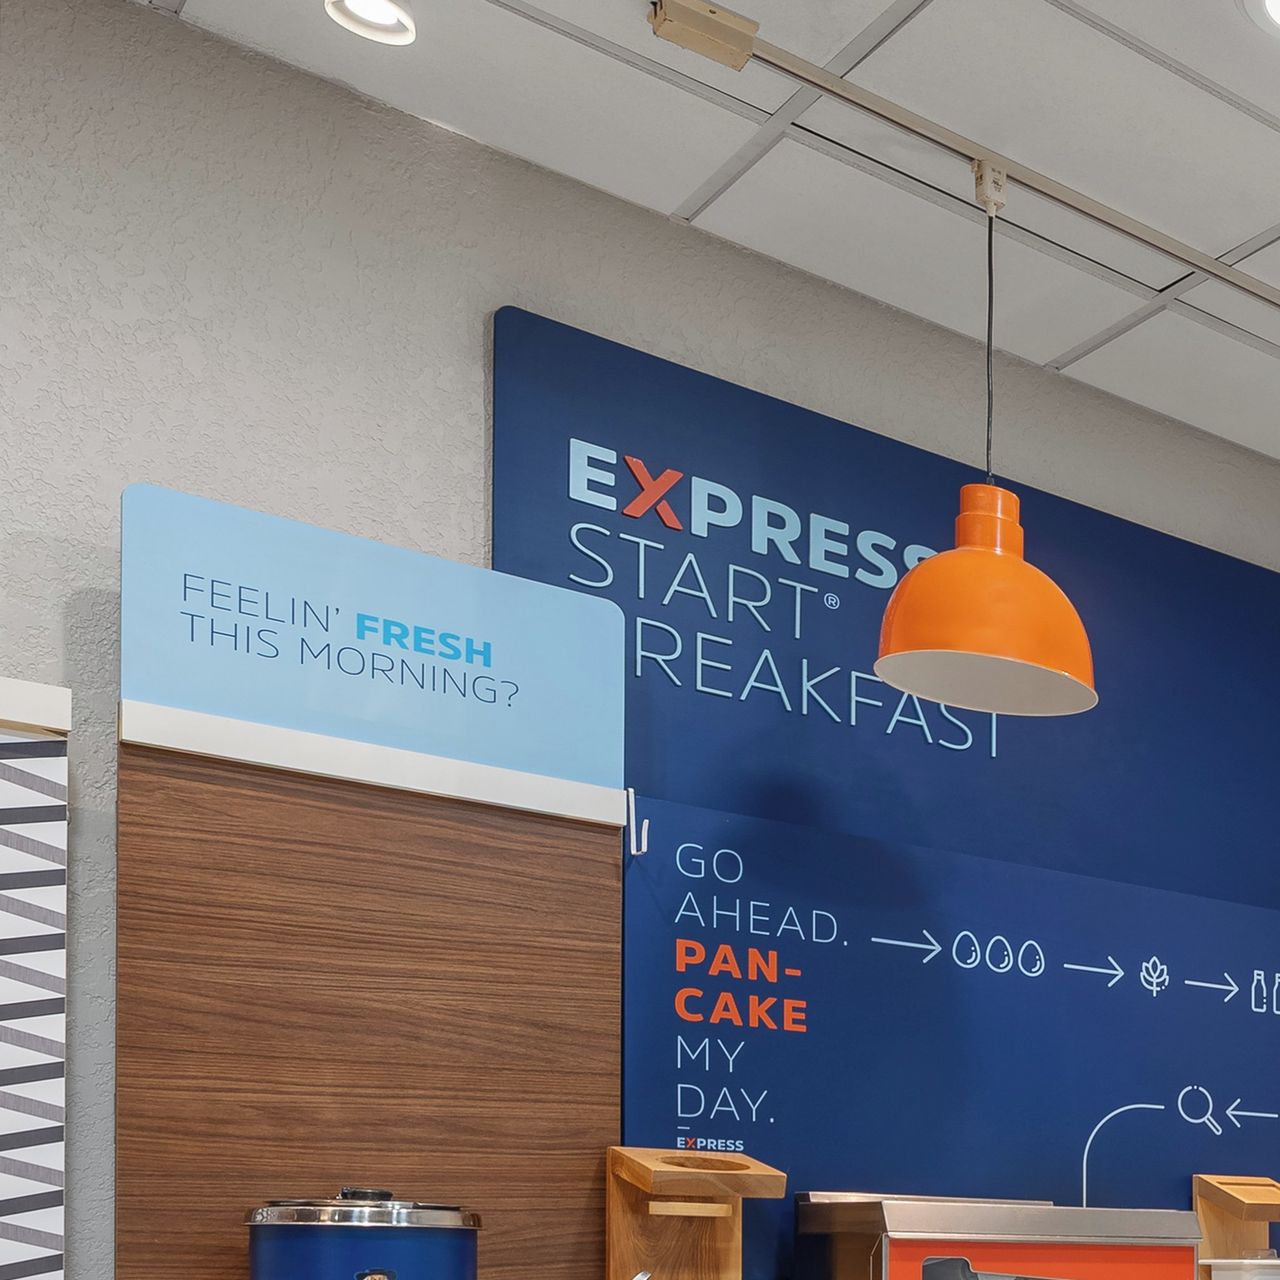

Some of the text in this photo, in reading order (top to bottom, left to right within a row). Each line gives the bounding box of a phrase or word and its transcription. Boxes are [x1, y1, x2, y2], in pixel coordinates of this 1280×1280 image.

[184, 573, 492, 668] FEELIN' FRESH
[180, 611, 519, 707] THIS MORNING?
[676, 843, 743, 883] GO
[674, 891, 848, 947] AHEAD.
[675, 938, 802, 983] PAN-
[674, 987, 807, 1033] CAKE
[677, 1035, 745, 1073] MY
[677, 1083, 774, 1123] DAY.
[676, 1136, 744, 1151] EXPRESS
